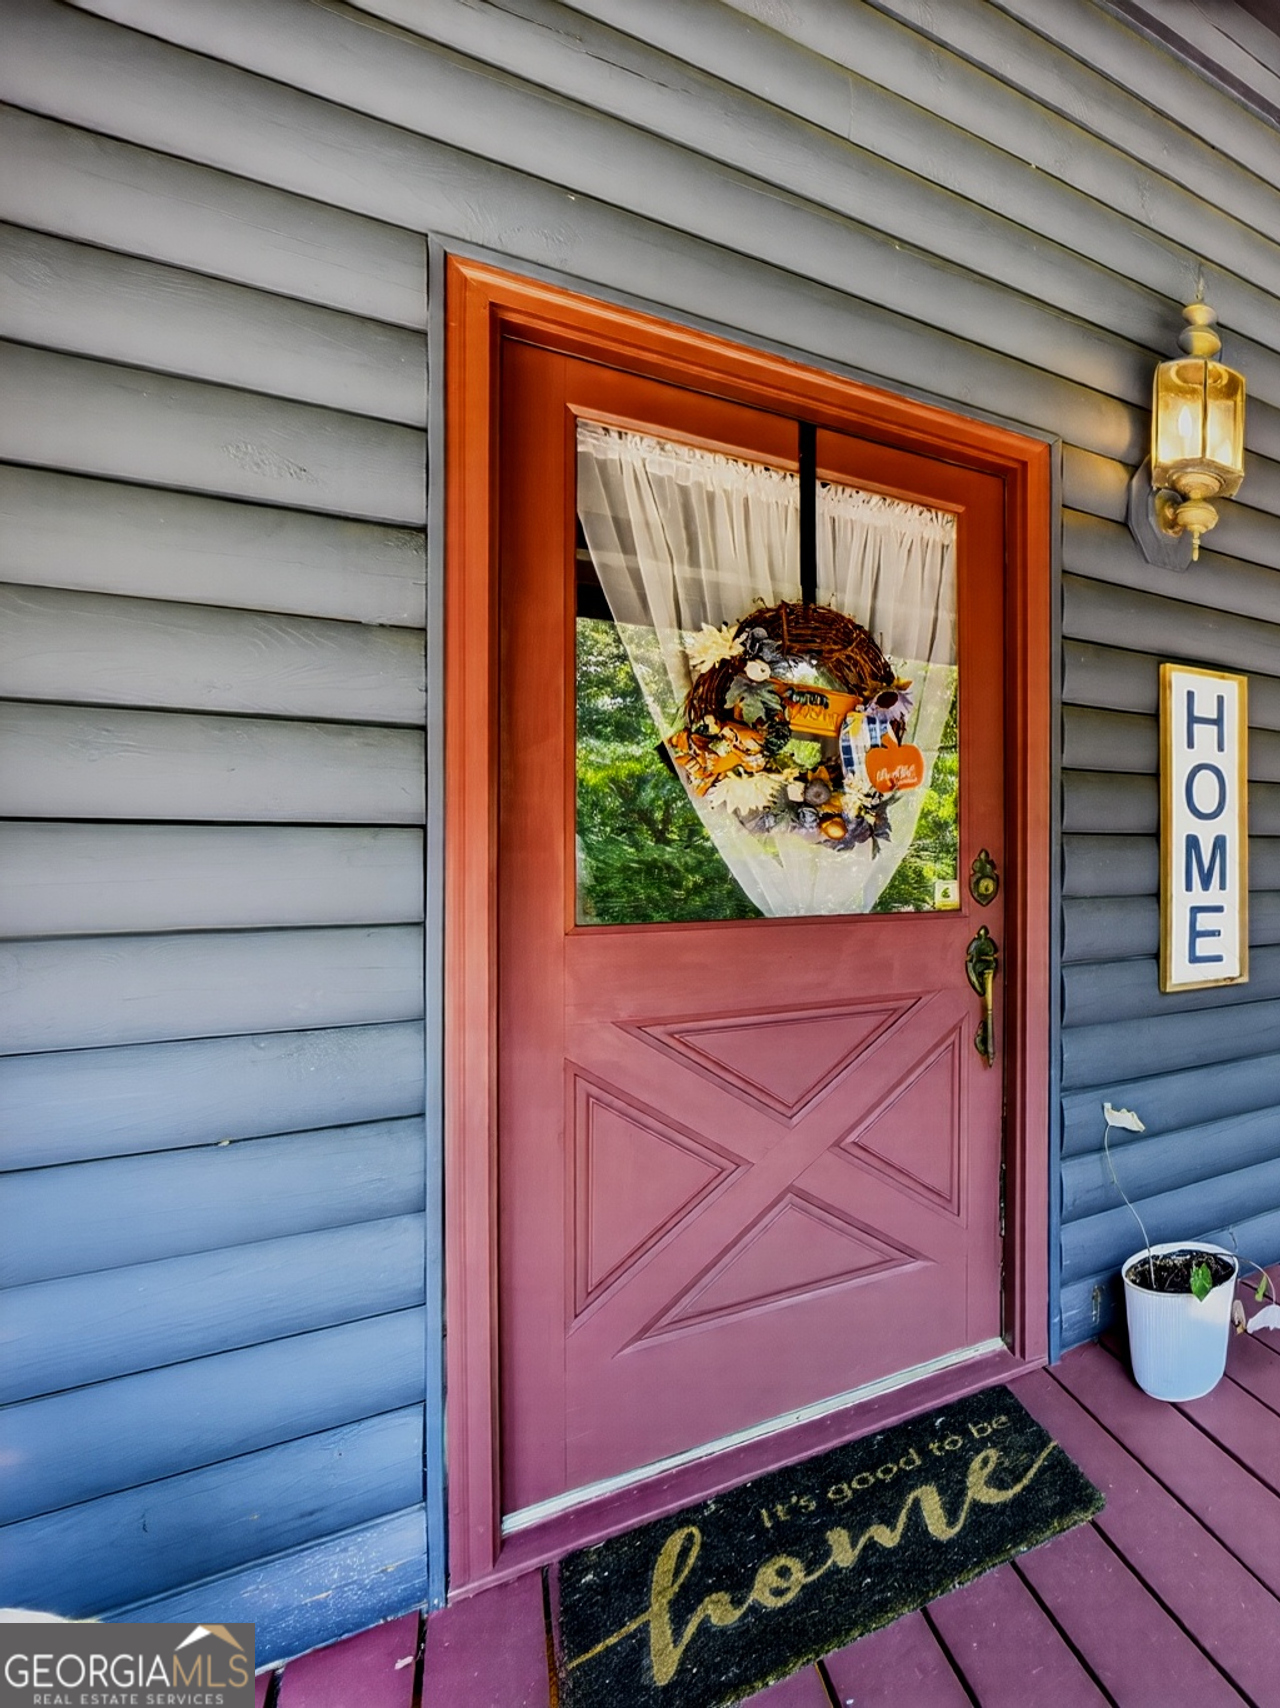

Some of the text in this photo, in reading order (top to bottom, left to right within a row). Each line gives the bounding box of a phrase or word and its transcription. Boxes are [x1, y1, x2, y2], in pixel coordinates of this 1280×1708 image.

[1185, 689, 1227, 965] HOME
[567, 1440, 1059, 1687] home
[761, 1415, 1009, 1529] It's good to be
